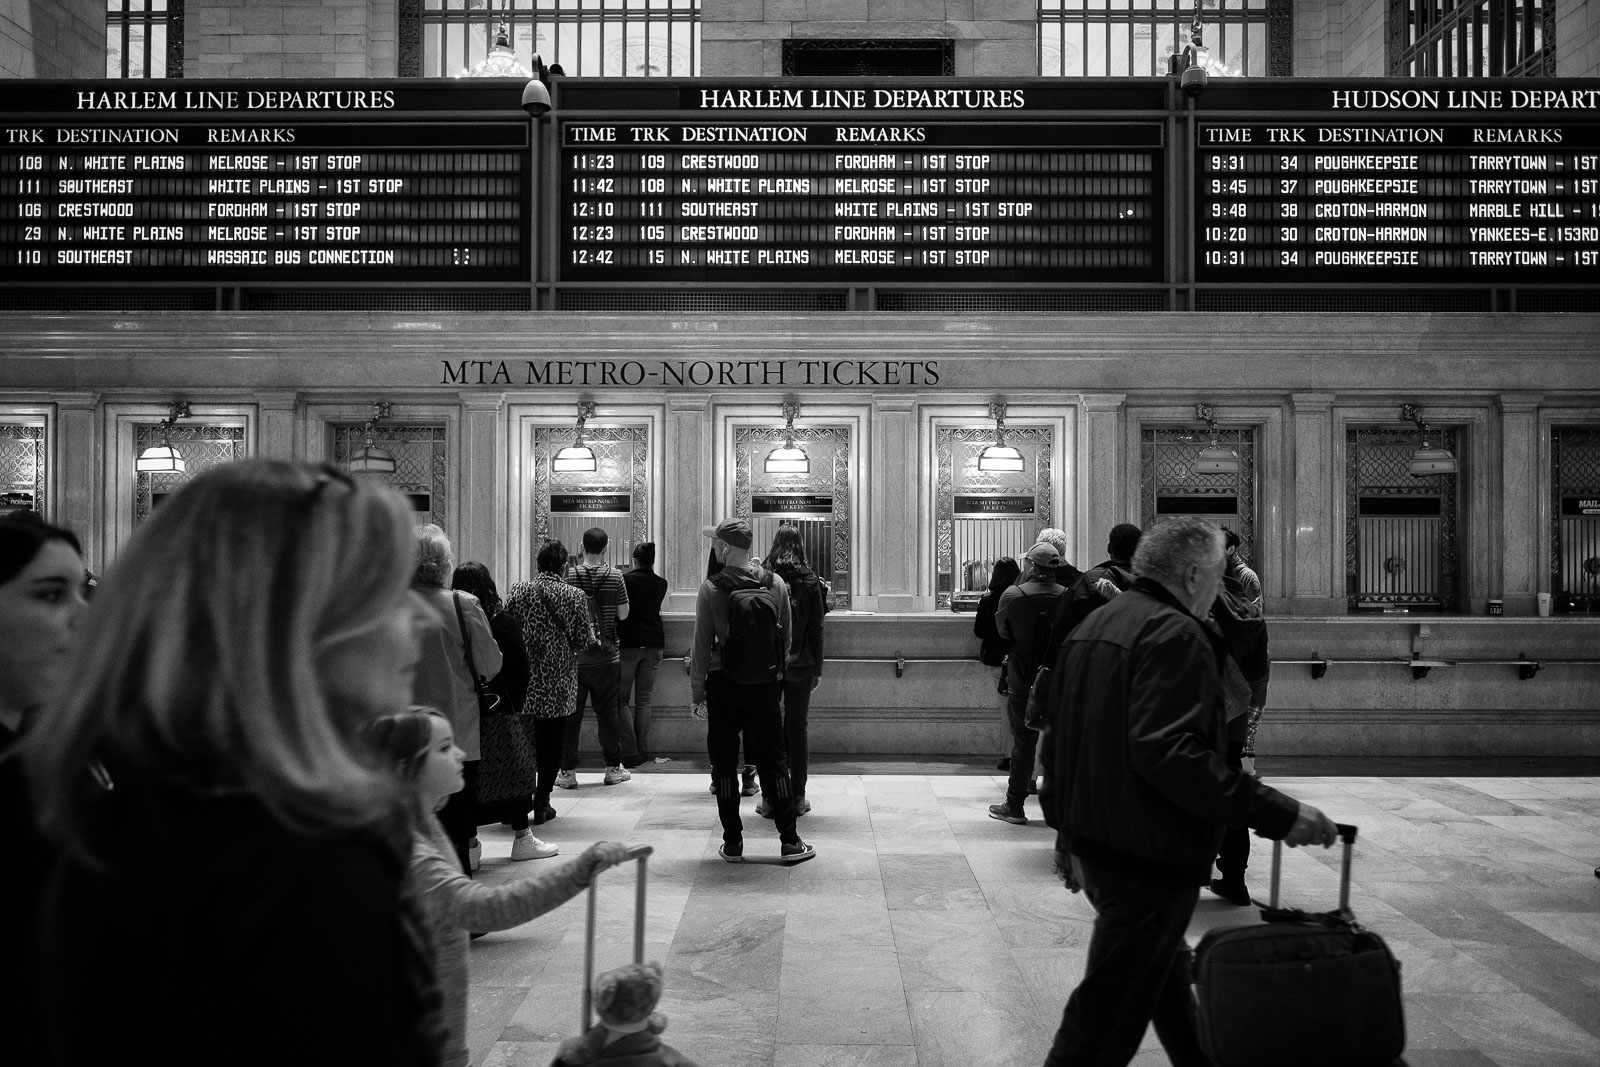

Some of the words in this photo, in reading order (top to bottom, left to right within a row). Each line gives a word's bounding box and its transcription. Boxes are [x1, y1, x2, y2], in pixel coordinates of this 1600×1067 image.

[77, 91, 177, 110] HARLEM
[185, 91, 239, 109] LINE
[247, 90, 395, 109] DEPARTURES
[700, 89, 804, 108] HARLEM
[810, 89, 866, 109] LINE
[873, 89, 1025, 109] DEPARTURES
[1332, 90, 1440, 109] HUDSON
[1447, 90, 1503, 109] LINE
[1510, 90, 1600, 109] DEPART
[6, 129, 44, 143] TRK
[57, 129, 179, 143] DESTINATION
[207, 128, 295, 143] REMARKS
[571, 127, 617, 142] TIME
[630, 127, 670, 142] TRK
[682, 126, 808, 142] DESTINATION
[835, 127, 926, 142] REMARKS
[1206, 128, 1252, 142] TIME
[1266, 128, 1306, 142] TRK
[1318, 128, 1444, 143] DESTINATION
[1474, 128, 1563, 143] REMARKS
[19, 156, 43, 170] 108
[59, 156, 73, 170] N.
[84, 156, 126, 170] WHITE
[134, 155, 184, 170] PLAINS
[209, 155, 269, 170] MELROSE
[295, 155, 319, 170] 1ST
[327, 155, 361, 170] STOP
[573, 154, 614, 169] 11:23
[641, 154, 665, 169] 109
[681, 154, 759, 169] CRESTWOOD
[835, 154, 896, 170] FORDHAM
[922, 154, 947, 170] 1ST
[955, 155, 990, 170] STOP
[1212, 155, 1244, 170] 9:31
[1280, 155, 1298, 170] 34
[1315, 155, 1419, 170] POUGHKEEPSIE
[1469, 155, 1547, 170] TARRYTOWN
[1573, 156, 1598, 170] 1ST
[19, 179, 40, 194] 111
[208, 179, 251, 194] WHITE
[259, 179, 310, 194] PLAINS
[336, 179, 361, 194] 1ST
[368, 179, 403, 193] STOP
[573, 178, 614, 193] 11:42
[640, 178, 665, 193] 108
[681, 178, 697, 193] N.
[707, 178, 751, 193] WHITE
[758, 178, 811, 194] PLAINS
[835, 178, 896, 194] MELROSE
[922, 178, 947, 193] 1ST
[955, 178, 990, 193] STOP
[1212, 179, 1247, 194] 9:45
[1280, 179, 1298, 194] 37
[1315, 178, 1418, 194] POUGHKEEPSIE
[1469, 179, 1547, 194] TARRYTOWN
[1574, 179, 1598, 194] 1ST
[18, 203, 42, 217] 106
[58, 203, 134, 217] CRESTWOOD
[208, 202, 268, 218] FORDHAM
[294, 203, 318, 218] 1ST
[326, 202, 361, 217] STOP
[572, 202, 614, 217] 12:10
[640, 202, 662, 217] 111
[681, 202, 759, 217] SOUTHEAST
[835, 202, 878, 217] WHITE
[886, 202, 938, 217] PLAINS
[965, 202, 990, 217] 1ST
[998, 202, 1033, 217] STOP
[1212, 203, 1247, 218] 9:48
[1280, 203, 1298, 217] 38
[1315, 202, 1427, 218] CROTON-HARMON
[1469, 203, 1522, 218] MARBLE
[1530, 203, 1564, 218] HILL
[1591, 203, 1600, 218] 1
[24, 226, 41, 241] 29
[58, 227, 72, 241] N.
[83, 226, 125, 241] WHITE
[133, 226, 184, 241] PLAINS
[208, 226, 268, 241] MELROSE
[294, 226, 318, 241] 1ST
[326, 226, 361, 241] STOP
[572, 225, 614, 241] 12:23
[640, 225, 665, 240] 105
[681, 225, 759, 241] CRESTWOOD
[834, 226, 896, 241] FORDHAM
[922, 226, 947, 241] 1ST
[955, 226, 990, 241] STOP
[1205, 227, 1247, 242] 10:20
[1280, 227, 1298, 242] 30
[1315, 227, 1427, 242] CROTON-HARMON
[1469, 227, 1599, 242] YANKEES-E.153RD
[18, 250, 41, 264] 110
[57, 249, 133, 264] SOUTHEAST
[207, 249, 267, 265] WASSAIC
[275, 250, 301, 265] BUS
[308, 249, 394, 264] CONNECTION
[572, 249, 614, 264] 12:42
[649, 249, 664, 264] 15
[681, 250, 696, 264] N.
[706, 249, 750, 265] WHITE
[758, 249, 810, 264] PLAINS
[834, 249, 896, 264] MELROSE
[922, 250, 947, 264] 1ST
[955, 249, 990, 265] STOP
[1205, 250, 1245, 265] 10:31
[1281, 251, 1298, 265] 34
[1315, 251, 1419, 265] POUGHKEEPSIE
[1469, 251, 1547, 266] TARRYTOWN
[1574, 251, 1599, 265] 1ST
[439, 359, 514, 385] MTA
[524, 360, 788, 386] METRO-NORTH
[797, 360, 939, 386] TICKETS
